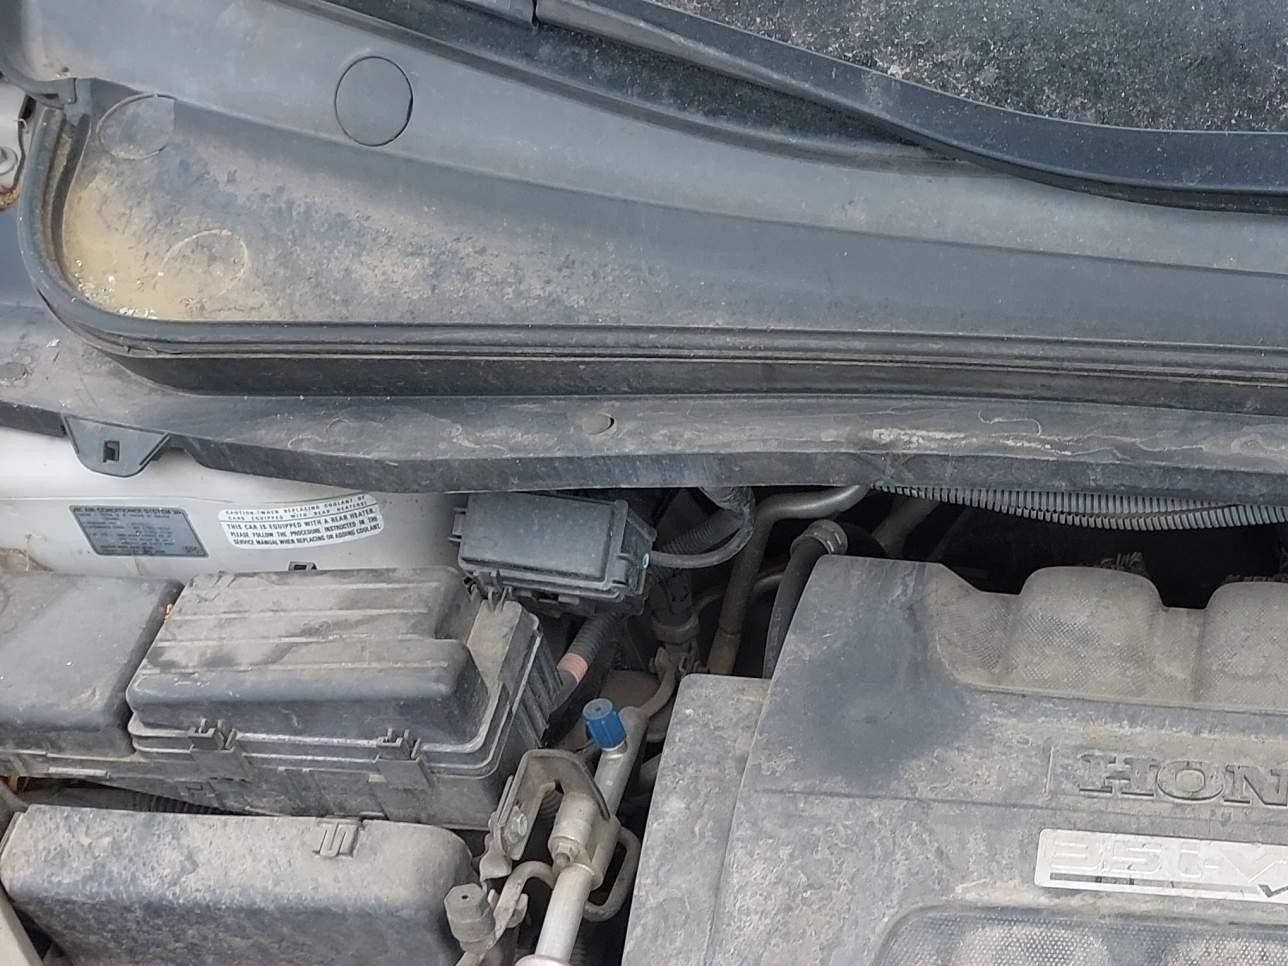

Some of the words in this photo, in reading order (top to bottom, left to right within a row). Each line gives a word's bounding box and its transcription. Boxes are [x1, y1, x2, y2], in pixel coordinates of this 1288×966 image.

[269, 520, 302, 530] EQUIPPED
[303, 519, 322, 527] WITH
[331, 515, 348, 523] REAR
[290, 528, 321, 536] PROCEDURE
[324, 522, 356, 532] INSTRUCTED
[280, 537, 295, 545] WHEN
[296, 535, 325, 544] REPLACING
